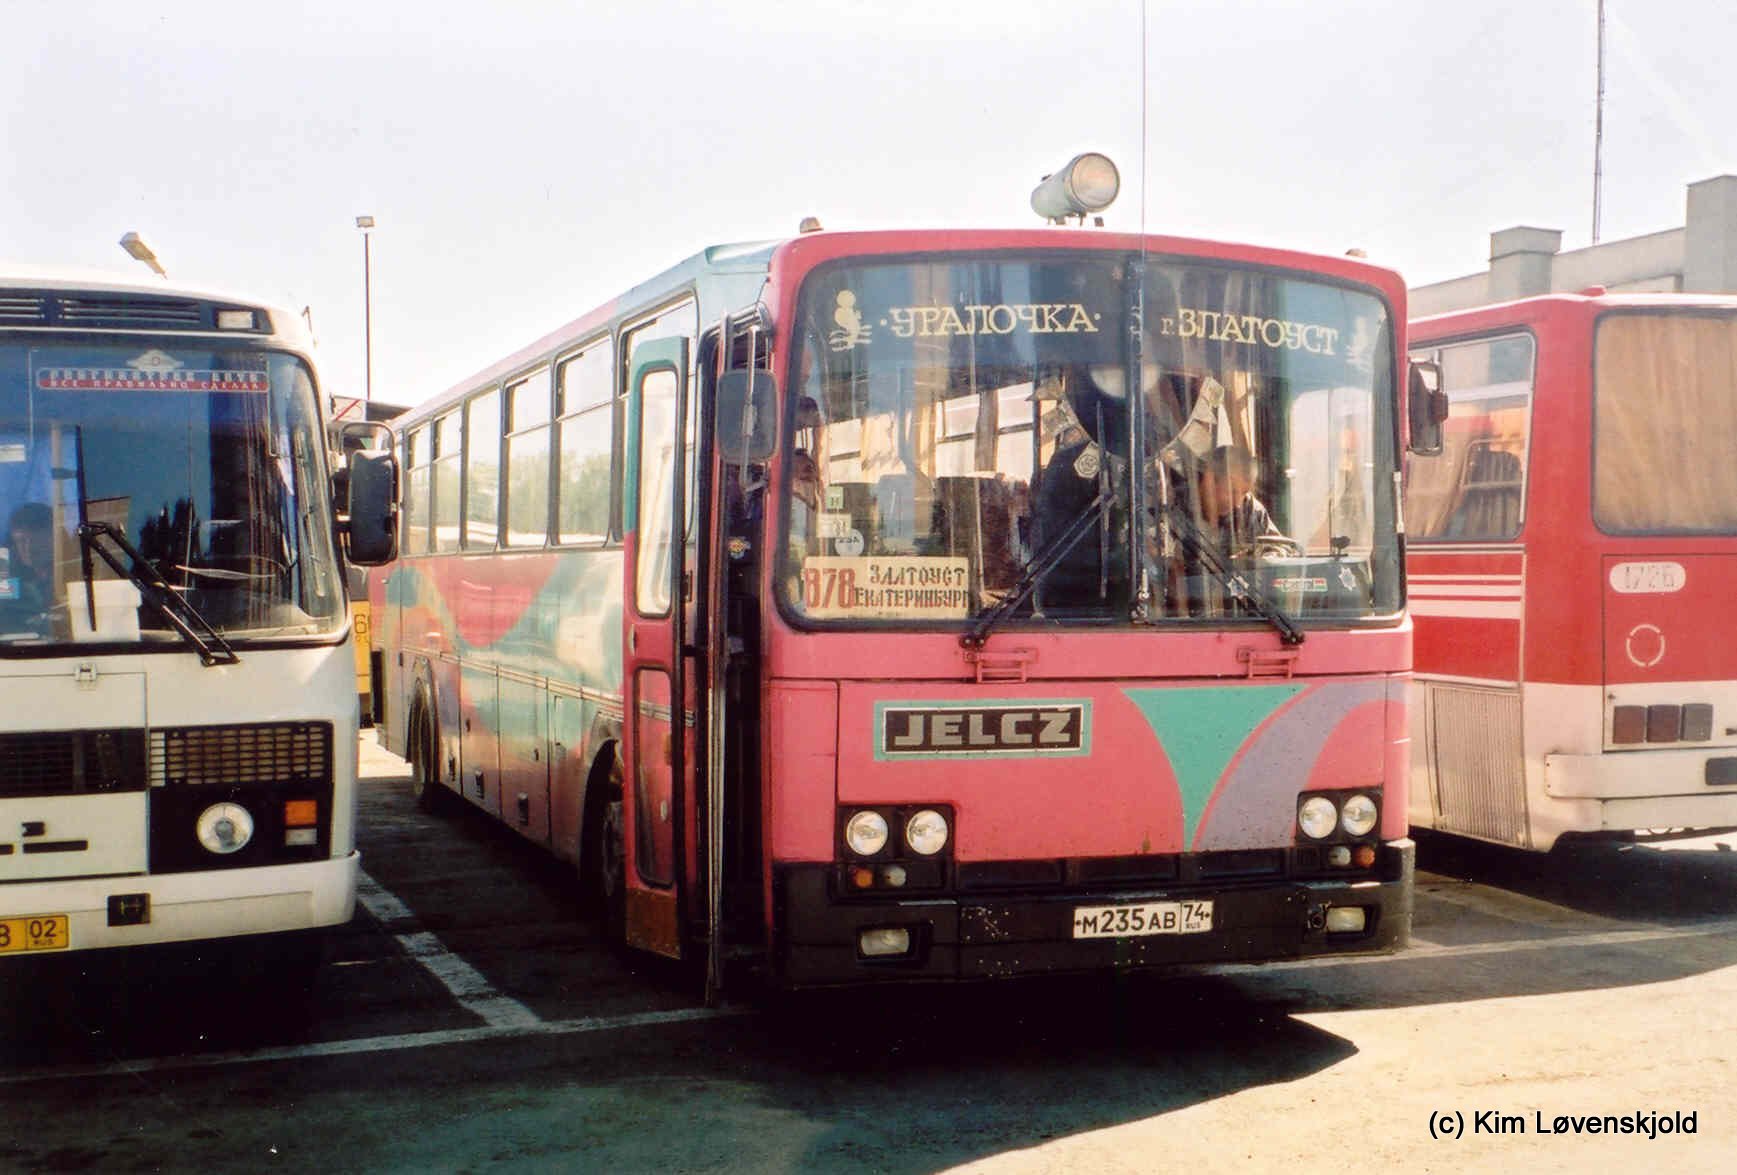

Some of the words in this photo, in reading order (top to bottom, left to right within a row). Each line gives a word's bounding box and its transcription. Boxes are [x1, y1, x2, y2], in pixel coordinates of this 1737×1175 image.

[889, 304, 1099, 337] УРАЛОЧКА
[804, 567, 856, 609] 878
[894, 712, 1072, 746] JELCZ
[30, 919, 57, 938] 02
[1183, 903, 1204, 921] 74
